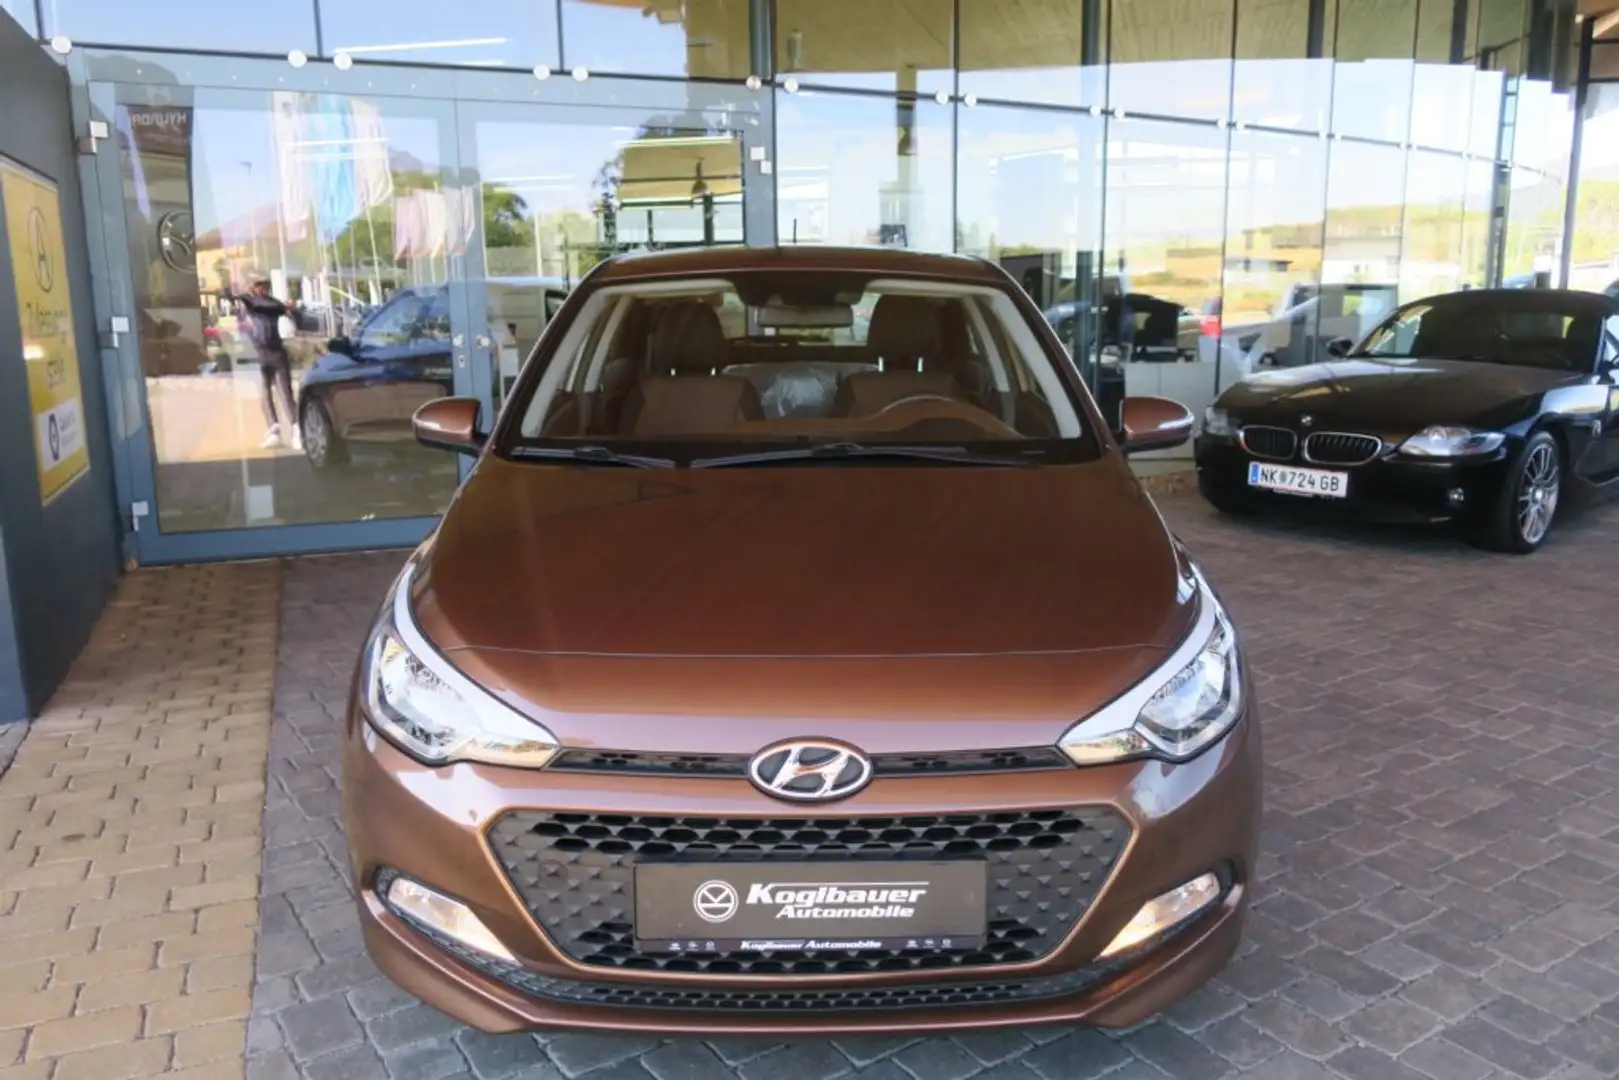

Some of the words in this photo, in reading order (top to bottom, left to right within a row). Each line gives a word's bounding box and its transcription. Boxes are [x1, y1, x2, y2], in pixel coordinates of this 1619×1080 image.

[1261, 468, 1277, 484] NK
[1289, 472, 1316, 489] 724
[1320, 475, 1340, 492] GB
[746, 883, 927, 907] Koglbauer
[775, 905, 915, 919] Automobile
[804, 940, 882, 950] Automobile
